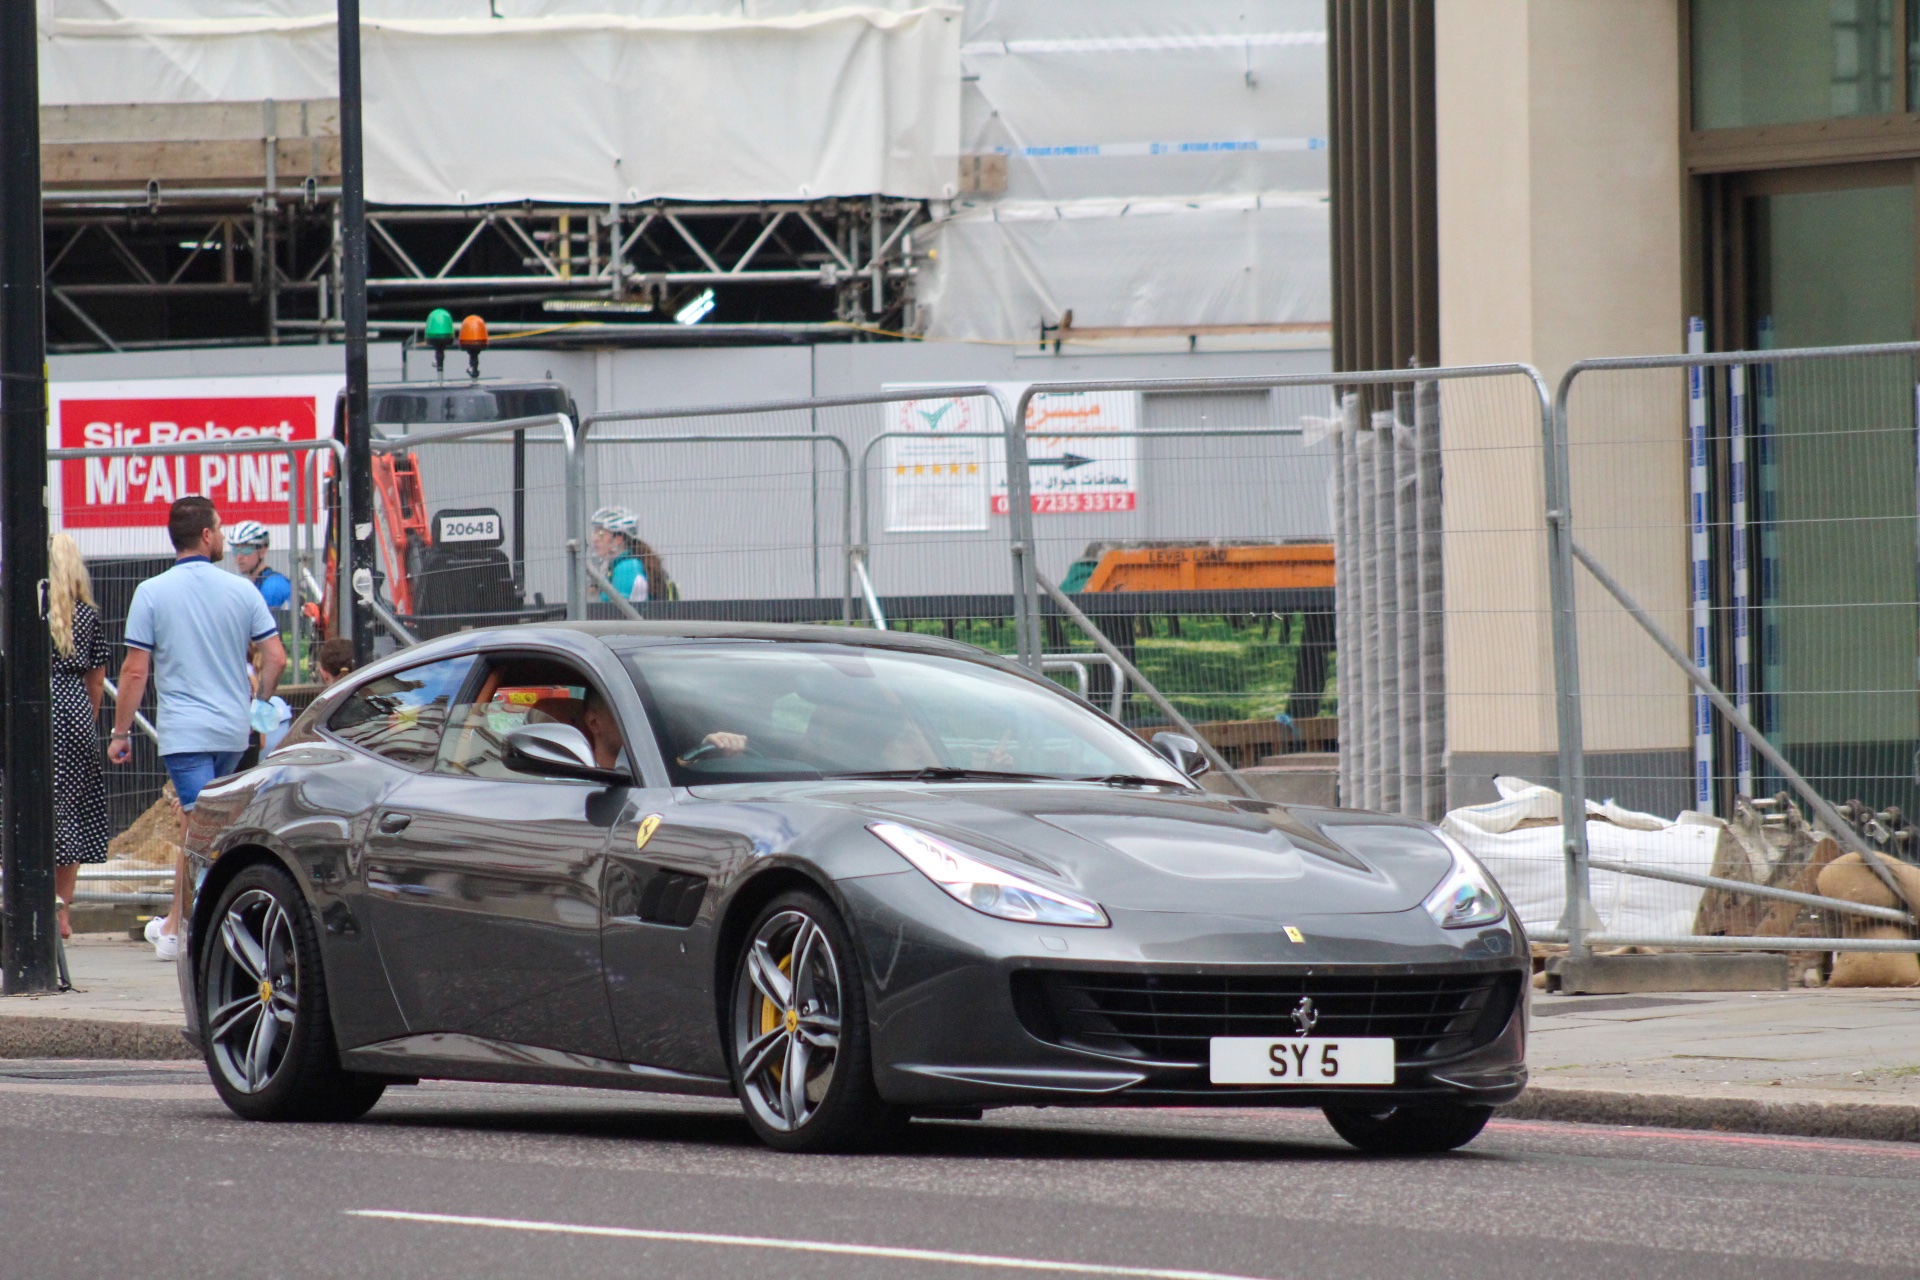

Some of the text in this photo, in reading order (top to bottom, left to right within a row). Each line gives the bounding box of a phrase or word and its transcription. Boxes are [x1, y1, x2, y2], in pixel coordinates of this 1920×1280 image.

[84, 421, 142, 449] Sir
[446, 521, 494, 536] 20648
[1269, 1043, 1338, 1077] SY 5
